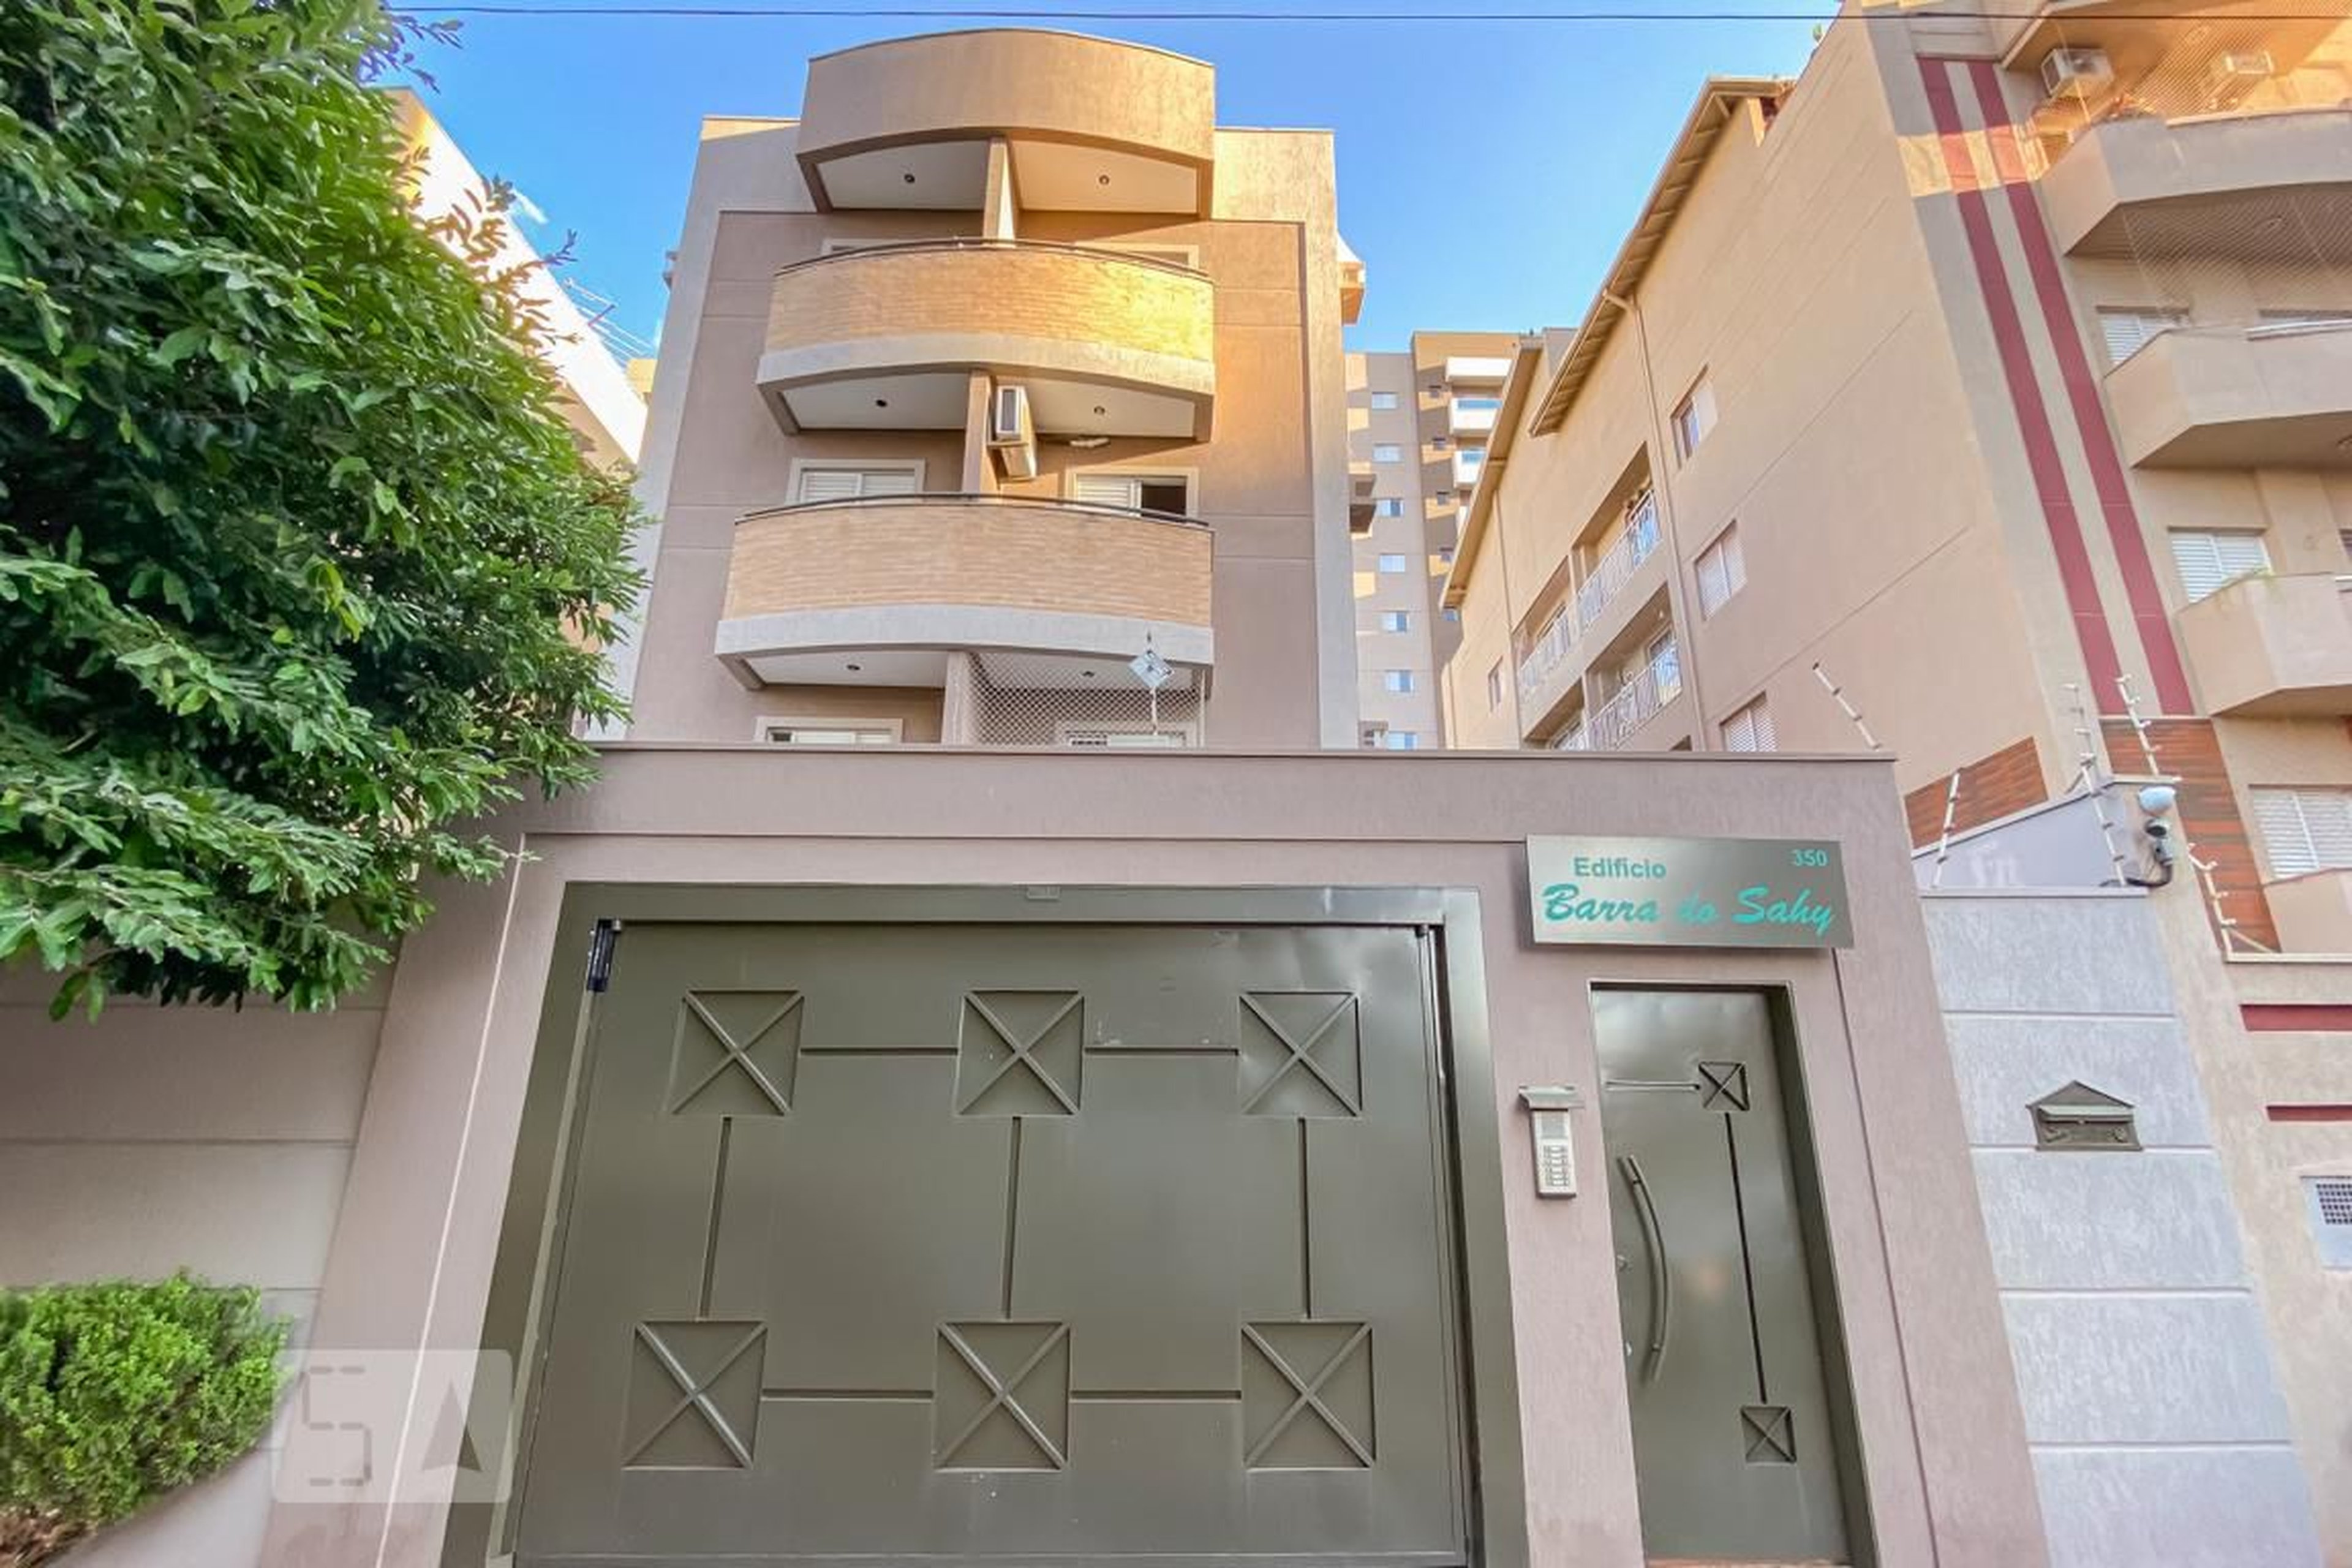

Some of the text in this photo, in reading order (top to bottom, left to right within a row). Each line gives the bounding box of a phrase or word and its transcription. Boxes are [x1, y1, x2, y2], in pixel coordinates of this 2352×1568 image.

[1792, 848, 1827, 867] 350
[1542, 884, 1831, 937] Barra do Sahy
